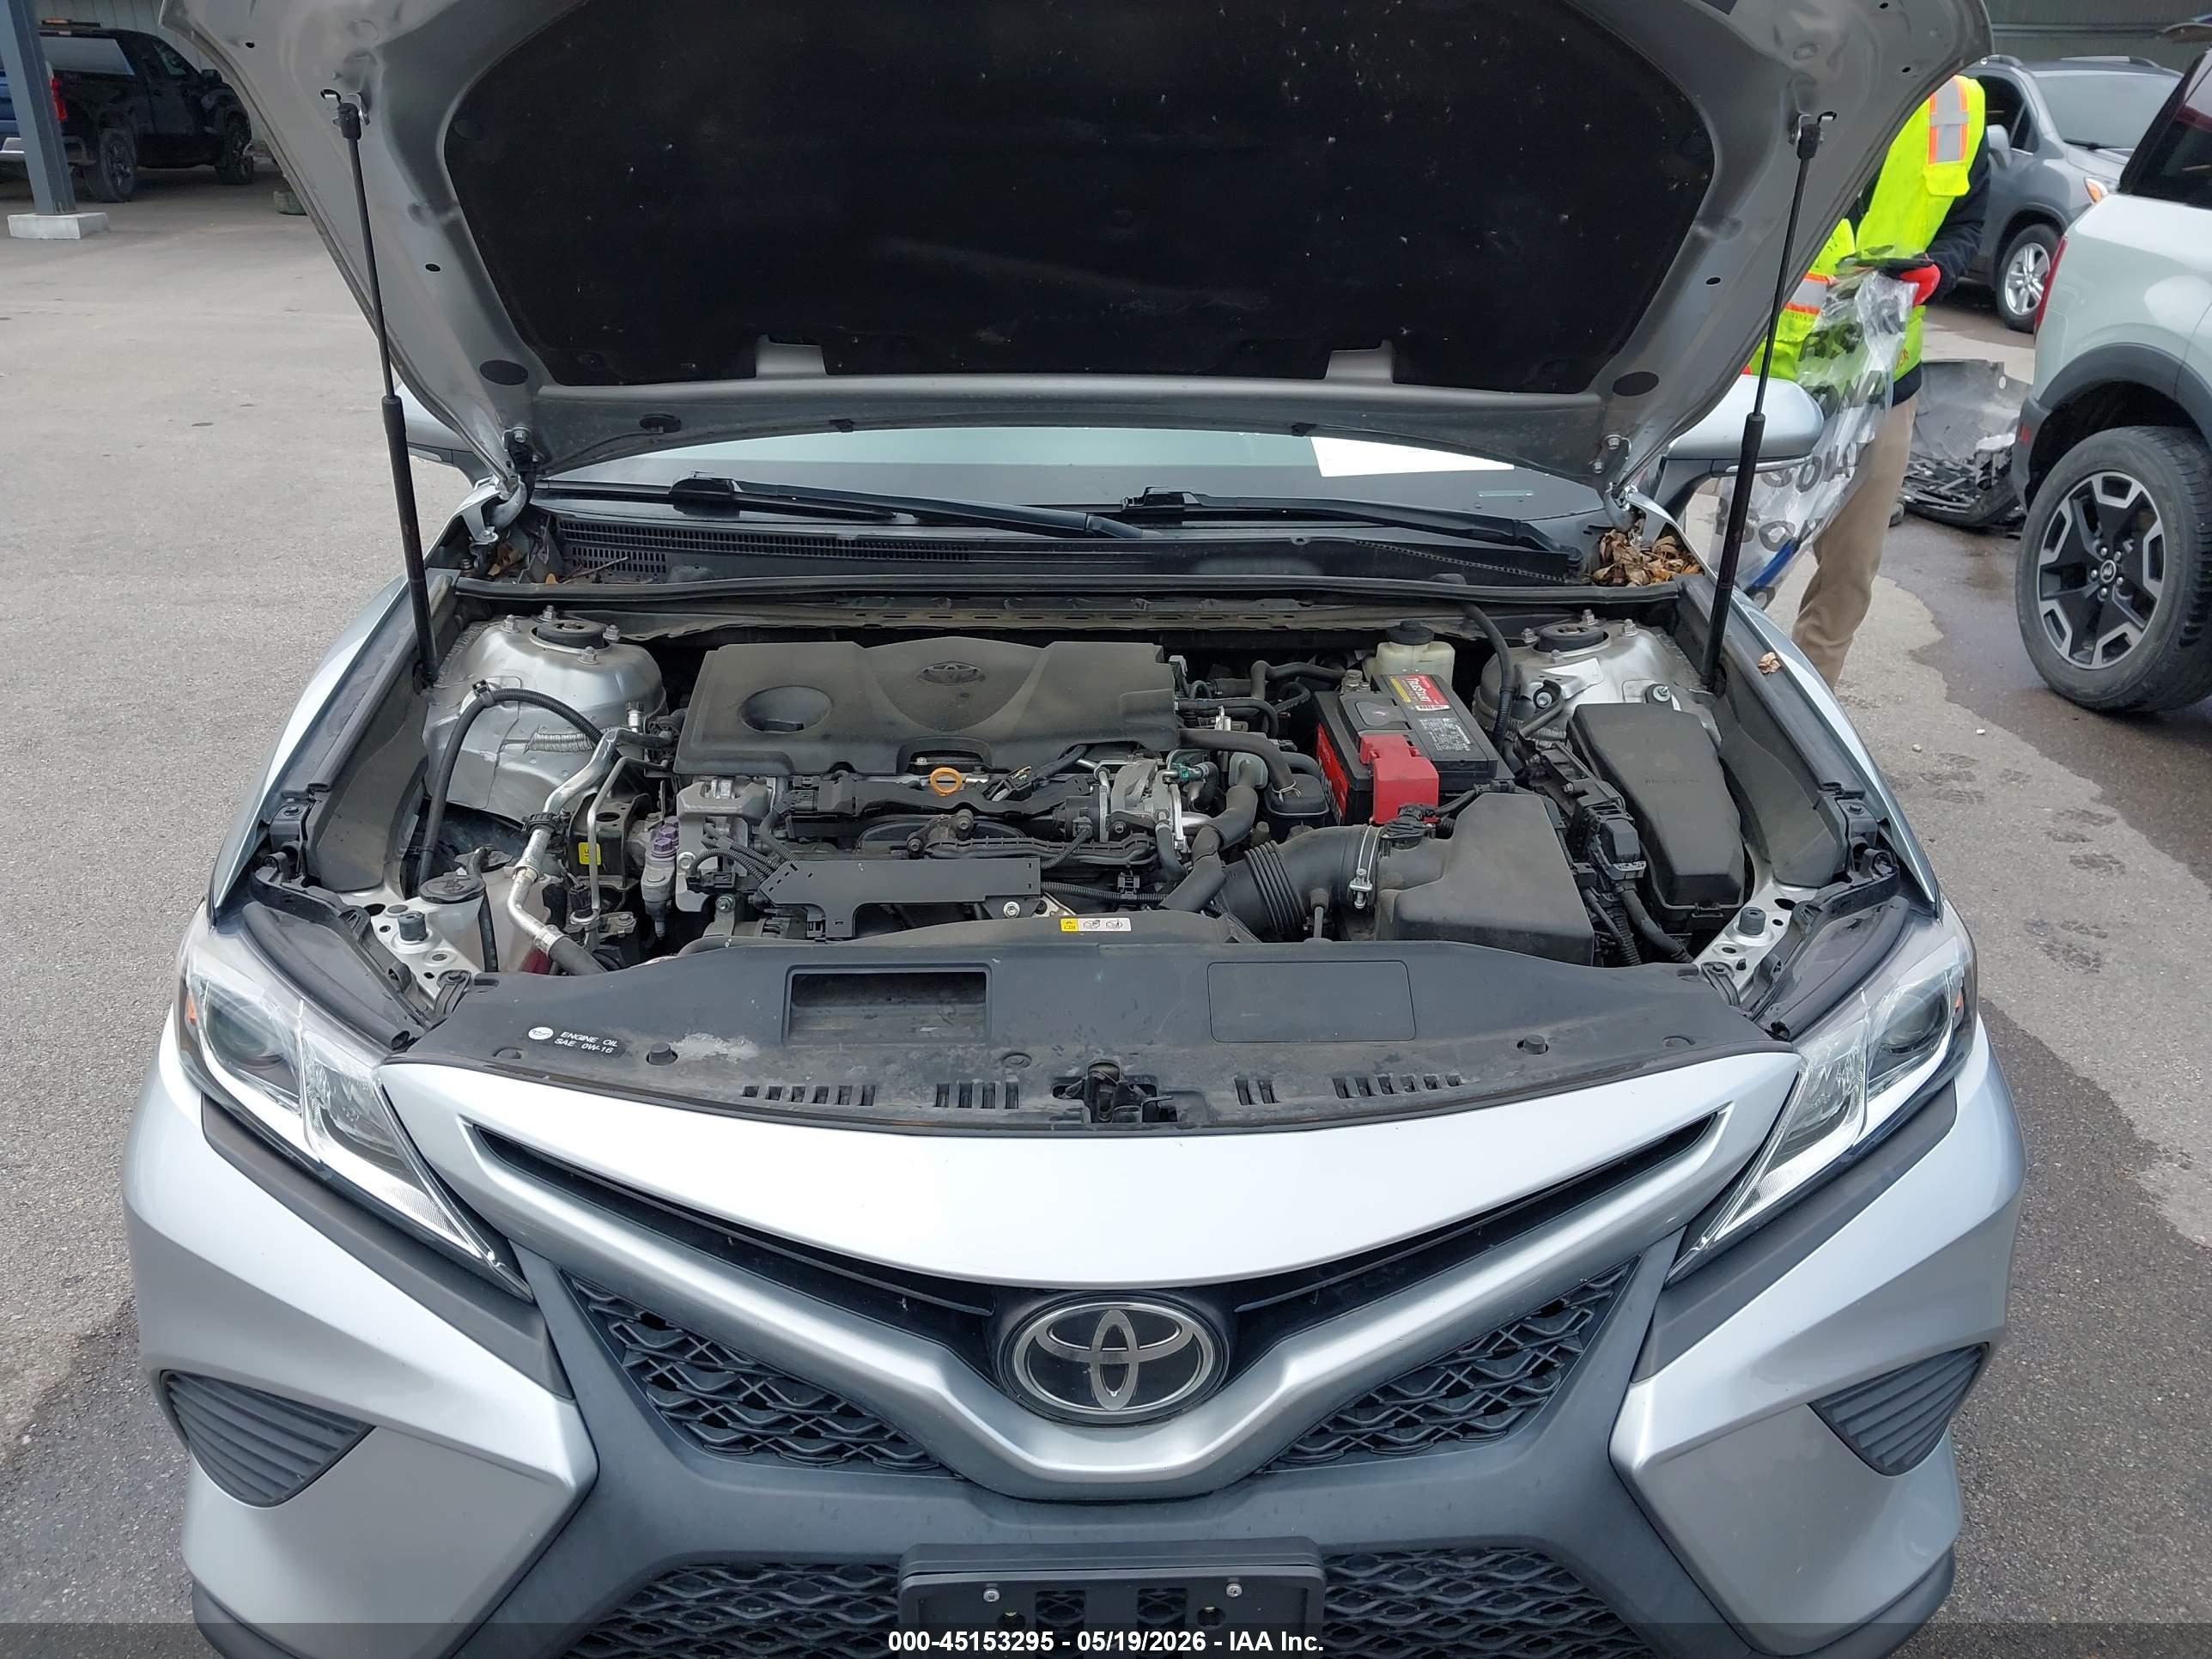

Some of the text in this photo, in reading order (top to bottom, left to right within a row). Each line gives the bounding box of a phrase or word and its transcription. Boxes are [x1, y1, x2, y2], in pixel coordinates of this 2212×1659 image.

[555, 1038, 614, 1054] SAE 0W-16
[561, 1031, 618, 1048] ENGINE OIL
